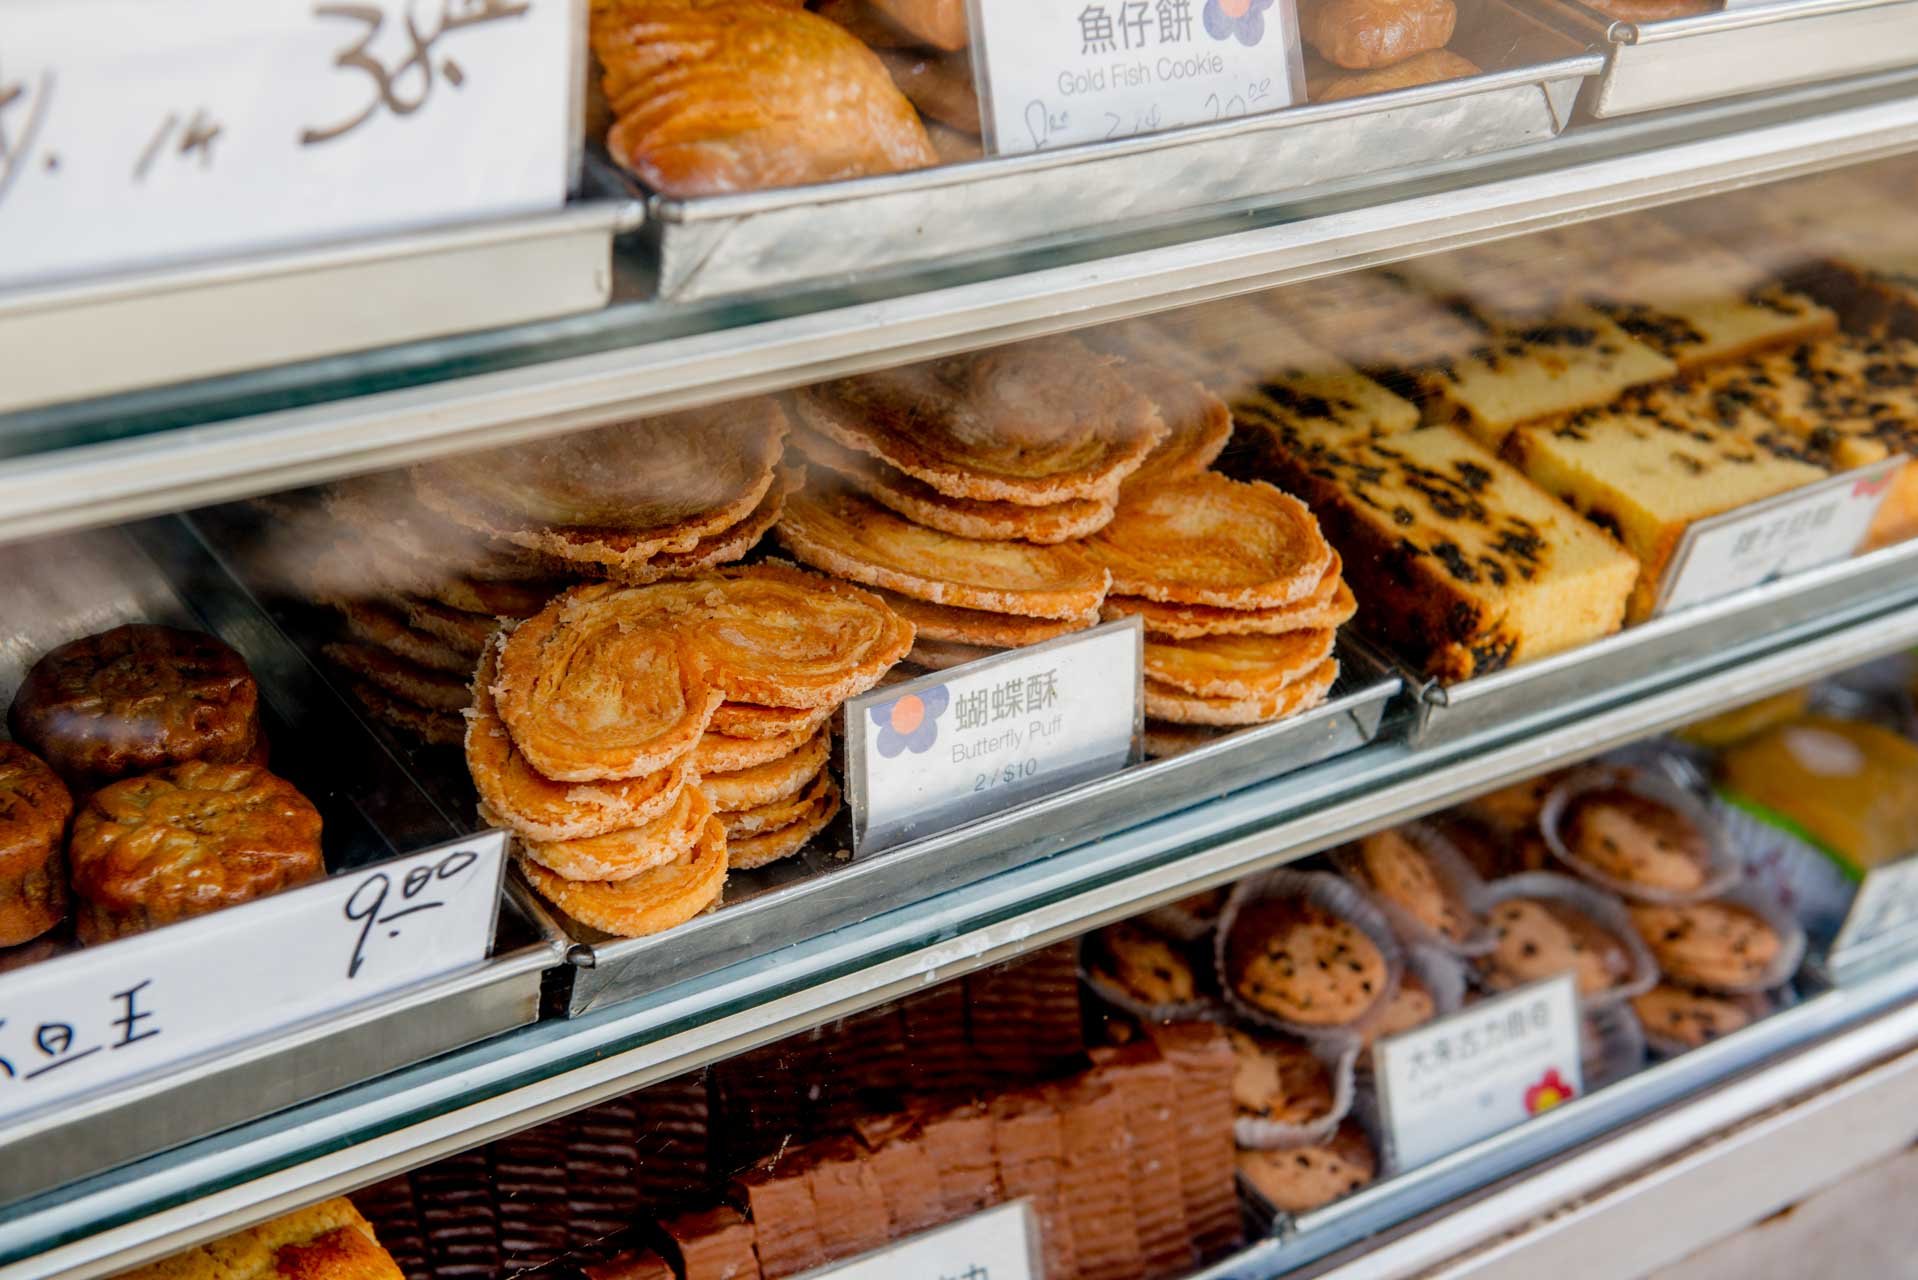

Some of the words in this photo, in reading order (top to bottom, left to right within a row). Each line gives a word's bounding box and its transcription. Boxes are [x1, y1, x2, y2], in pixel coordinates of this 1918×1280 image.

[1077, 0, 1193, 55] 魚仔餅
[1057, 69, 1105, 97] Gold
[1112, 61, 1152, 89] Fish
[1156, 52, 1224, 81] Cookie
[955, 668, 1060, 733] 蝴蝶酥
[951, 726, 1024, 764] Butterfly
[1028, 714, 1063, 742] Puff
